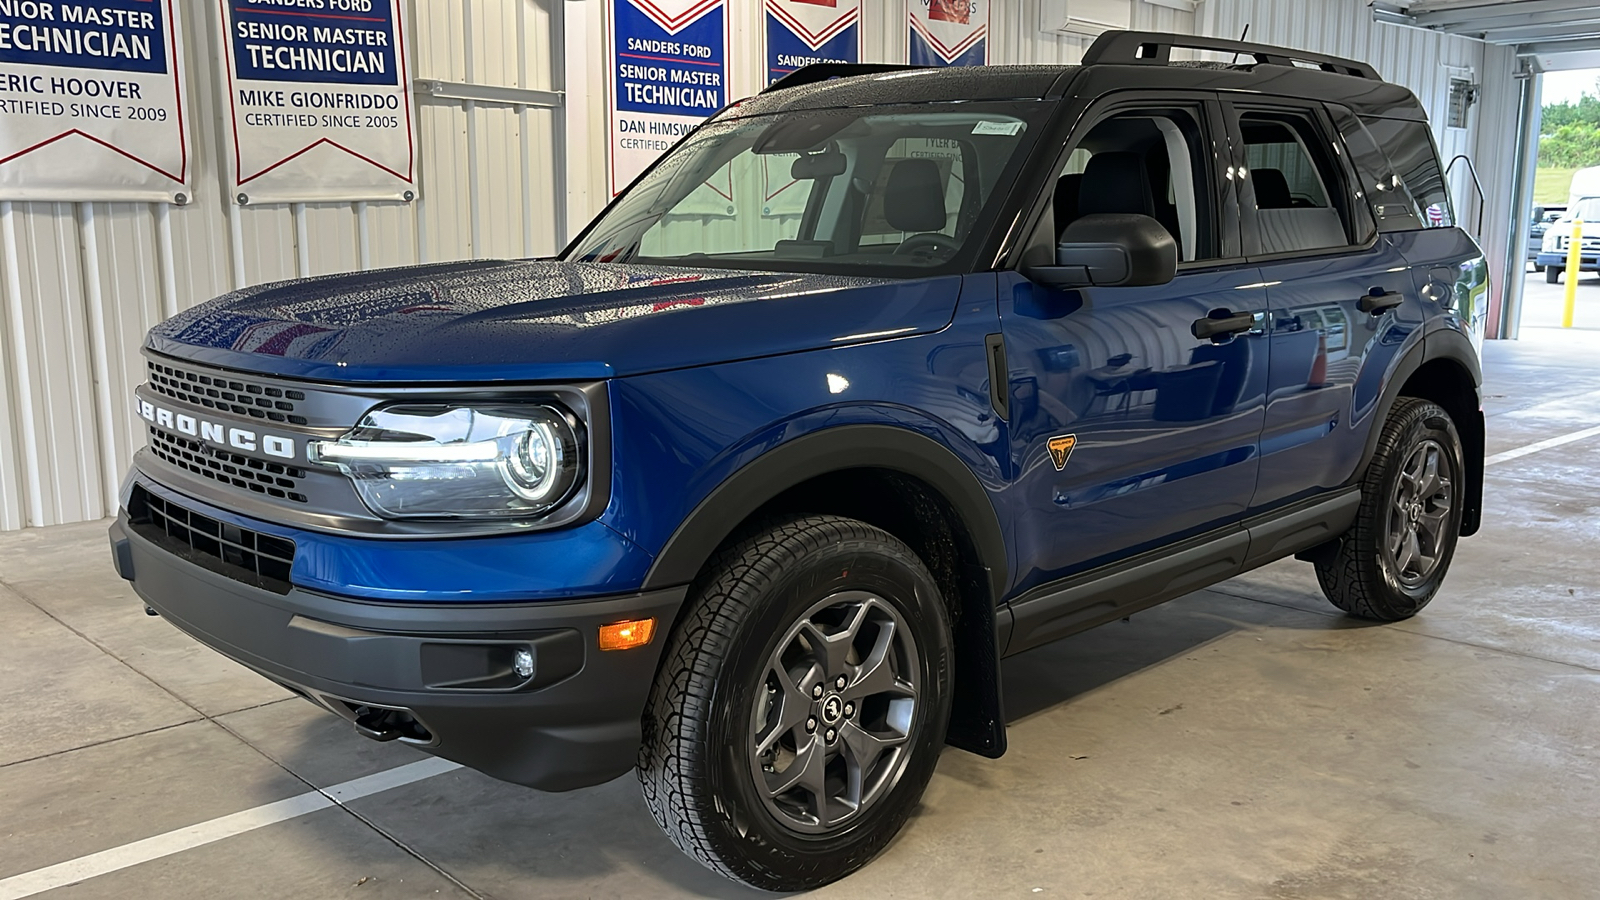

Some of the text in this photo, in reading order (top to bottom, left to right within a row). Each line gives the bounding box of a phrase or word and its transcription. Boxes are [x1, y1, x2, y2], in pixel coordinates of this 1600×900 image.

[329, 0, 372, 12] FORD
[61, 4, 155, 29] MASTER
[237, 21, 388, 46] SENIOR MASTER
[627, 37, 711, 58] SANDERS FORD
[245, 44, 385, 73] TECHNICIAN
[619, 64, 721, 86] SENIOR MASTER
[0, 74, 142, 99] ERIC HOOVER
[624, 82, 718, 109] TECHNICIAN
[239, 90, 399, 110] MIKE GIONFRIDDO
[70, 103, 122, 119] SINCE
[127, 106, 167, 121] 2009
[245, 113, 398, 128] CERTIFIED SINCE 2005
[619, 119, 646, 134] DAN
[620, 138, 668, 151] CERTIFIED
[925, 137, 949, 148] TYLER
[911, 150, 945, 159] CERTIFIED
[141, 400, 295, 459] BRONCO
